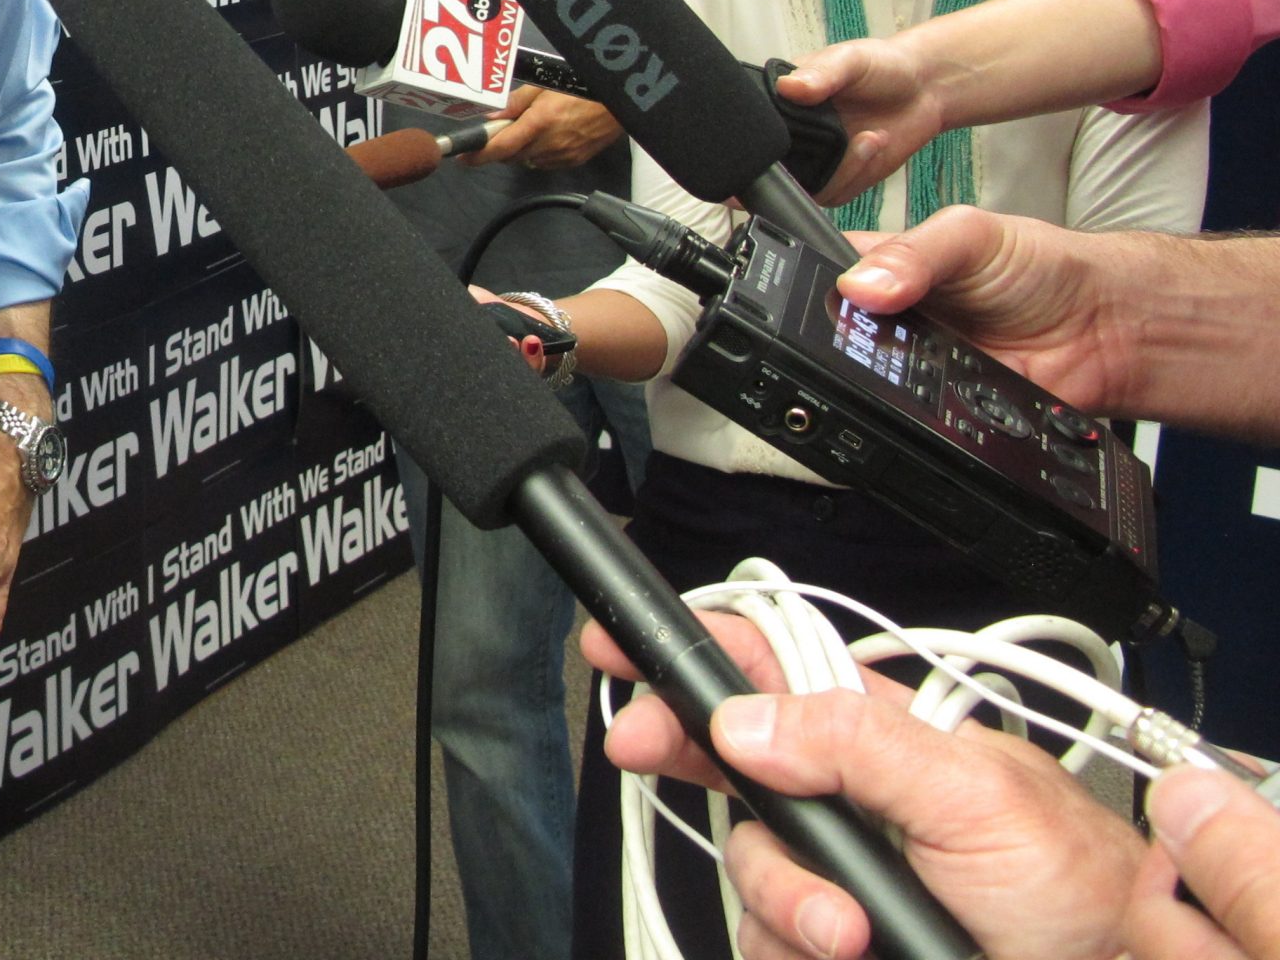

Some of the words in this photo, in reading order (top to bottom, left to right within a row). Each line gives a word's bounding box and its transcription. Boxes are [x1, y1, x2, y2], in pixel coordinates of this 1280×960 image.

[488, 2, 517, 89] WKOW
[76, 125, 132, 173] With
[81, 358, 138, 411] With
[166, 306, 233, 376] Stand
[149, 350, 295, 478] Walker
[334, 432, 384, 483] Stand
[163, 514, 232, 595] Stand
[240, 485, 295, 538] With
[299, 467, 409, 586] Walke
[85, 582, 138, 637] With
[148, 547, 298, 691] Walker
